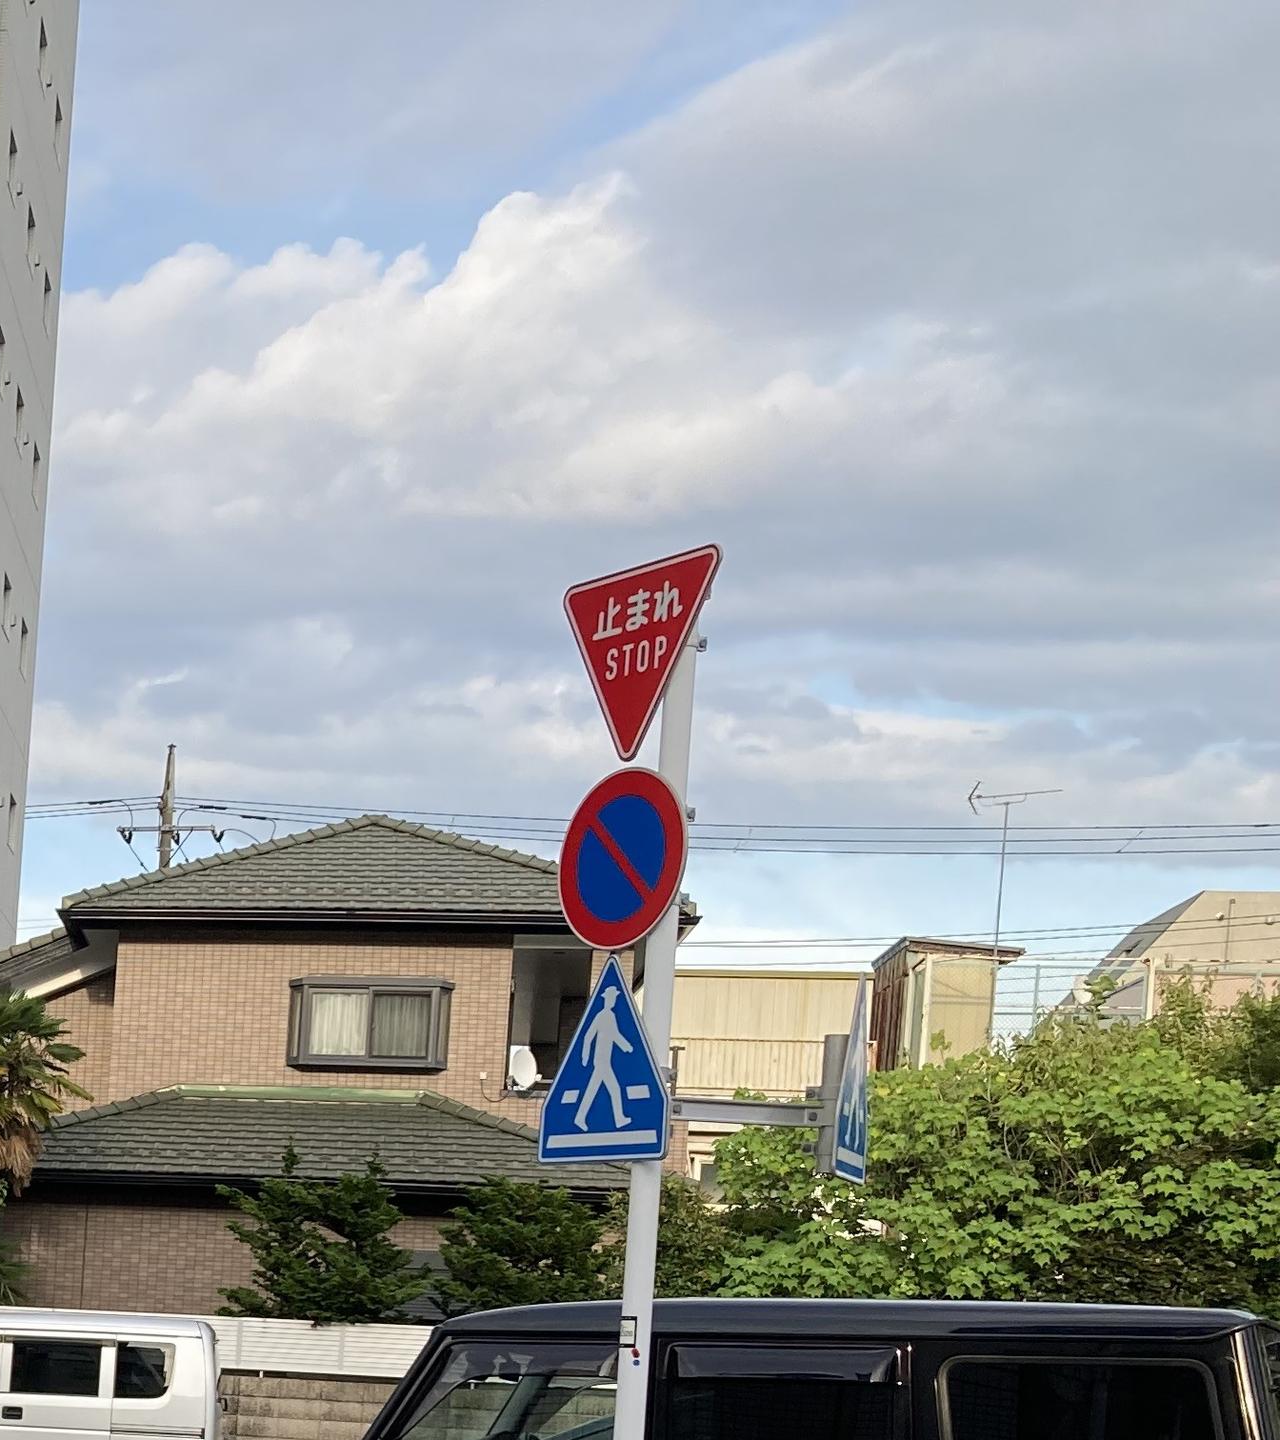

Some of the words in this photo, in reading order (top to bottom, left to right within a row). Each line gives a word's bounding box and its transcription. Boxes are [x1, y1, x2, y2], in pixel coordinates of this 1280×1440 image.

[592, 579, 684, 641] 止まれ
[604, 635, 668, 681] STOP
